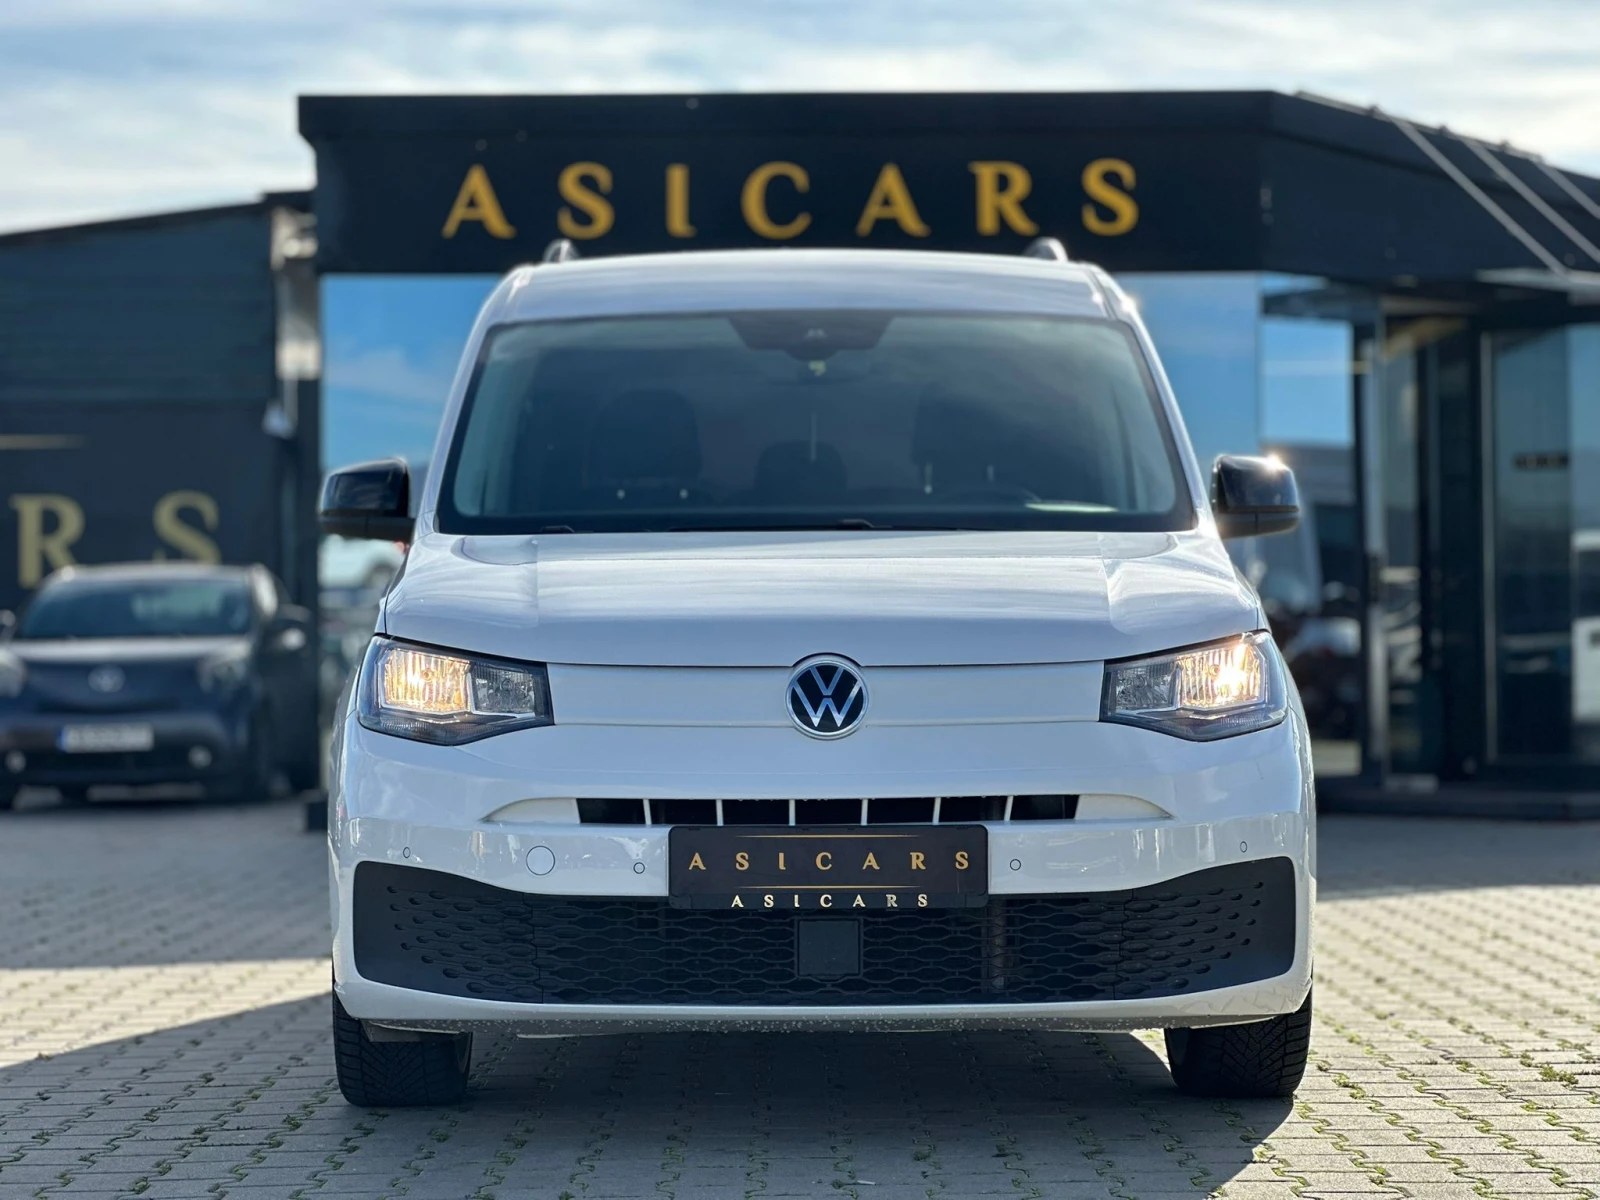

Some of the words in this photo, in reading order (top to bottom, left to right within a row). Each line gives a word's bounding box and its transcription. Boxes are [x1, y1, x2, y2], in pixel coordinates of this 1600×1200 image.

[442, 158, 1139, 239] ASICARS
[688, 851, 970, 871] ASICARS
[730, 893, 929, 909] ASICARS
